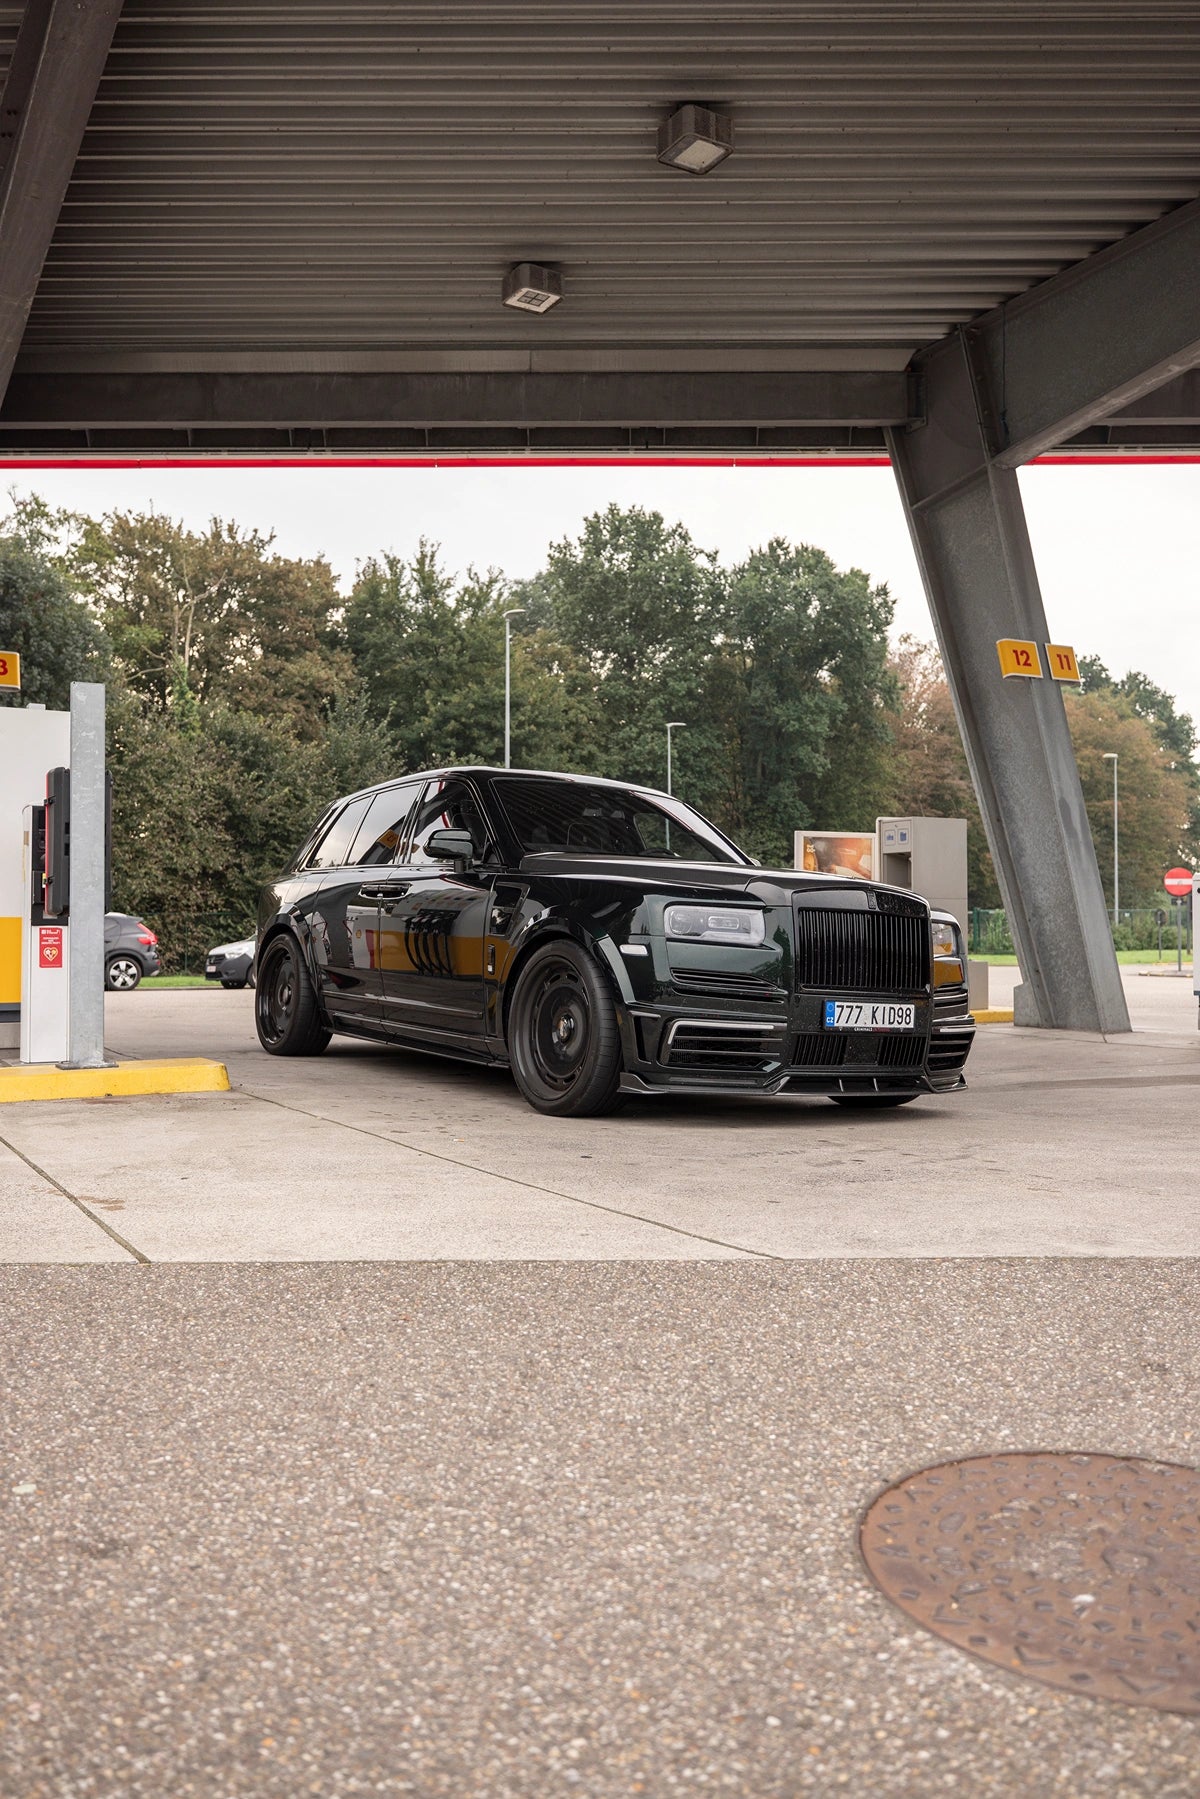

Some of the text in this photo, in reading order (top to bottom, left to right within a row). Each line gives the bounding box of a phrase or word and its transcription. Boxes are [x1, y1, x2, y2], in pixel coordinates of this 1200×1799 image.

[1012, 649, 1032, 667] 12
[1056, 653, 1072, 671] 11
[836, 1004, 912, 1025] 777 KID98
